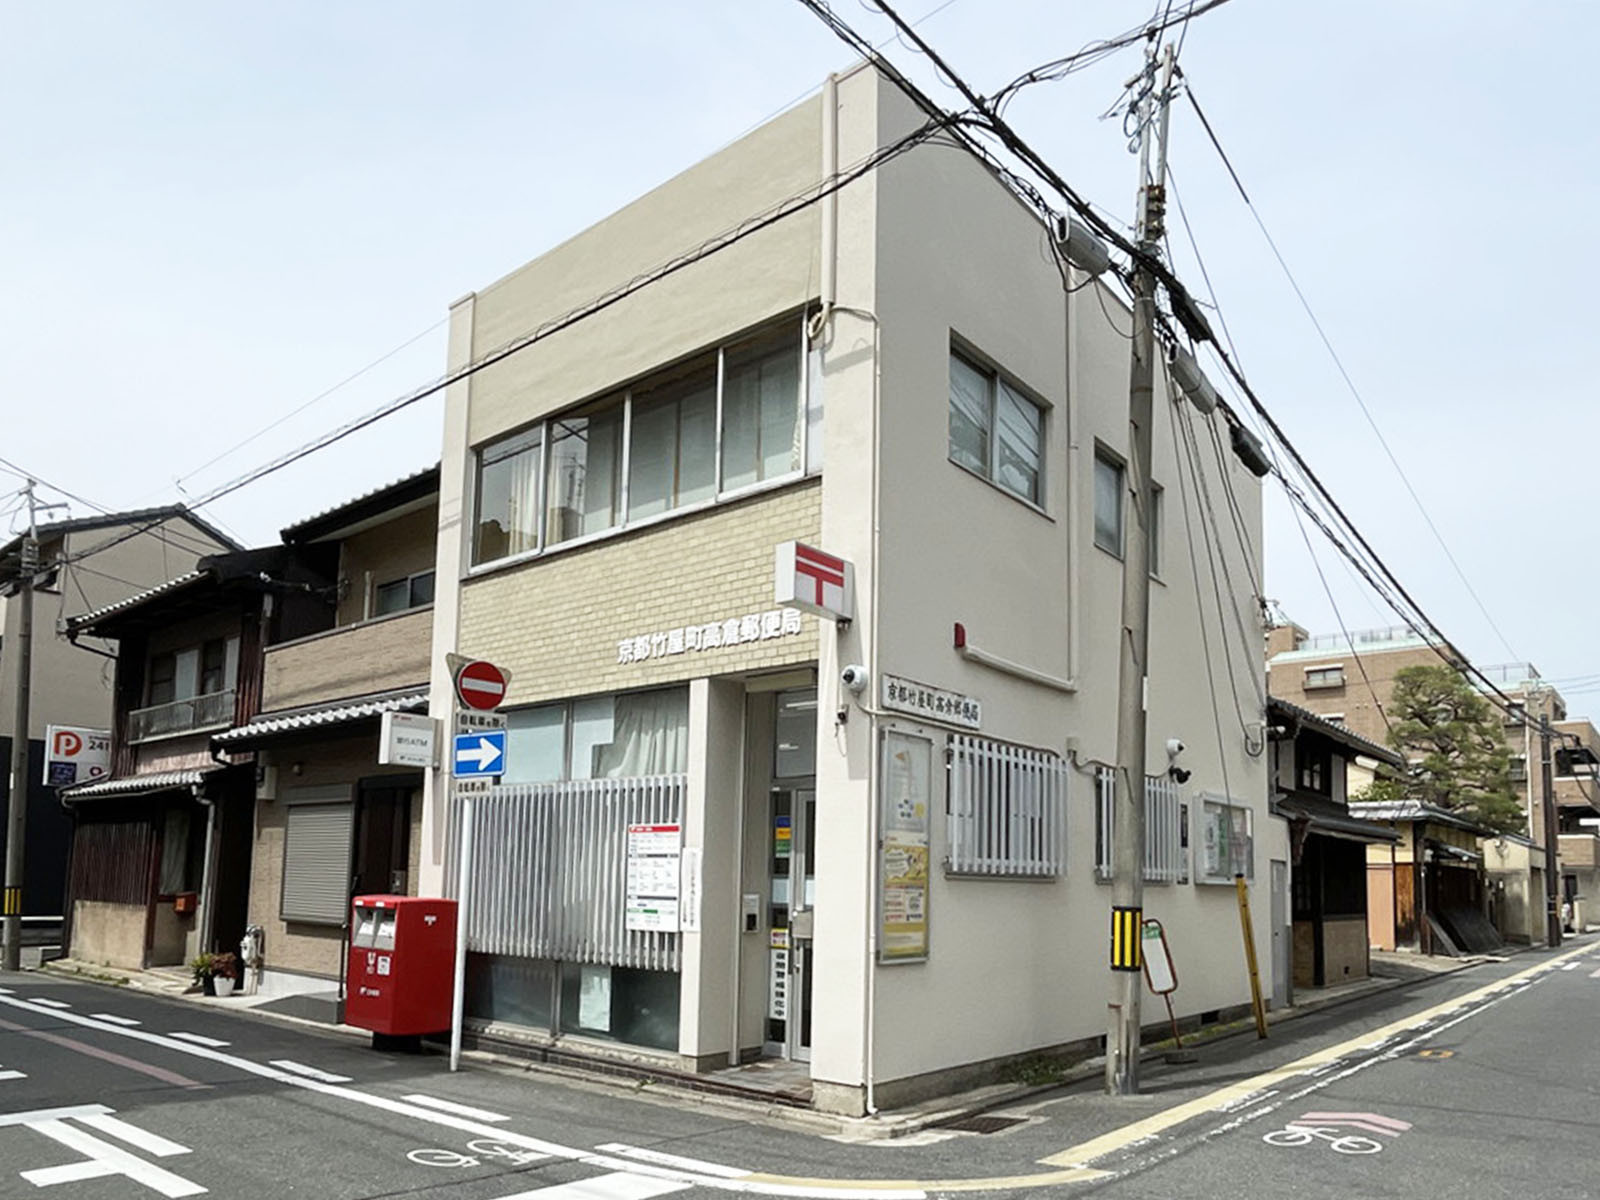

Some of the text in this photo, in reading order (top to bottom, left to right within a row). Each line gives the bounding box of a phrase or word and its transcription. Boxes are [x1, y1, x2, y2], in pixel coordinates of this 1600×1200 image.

[617, 608, 801, 664] 京都竹屋町高倉郵便局
